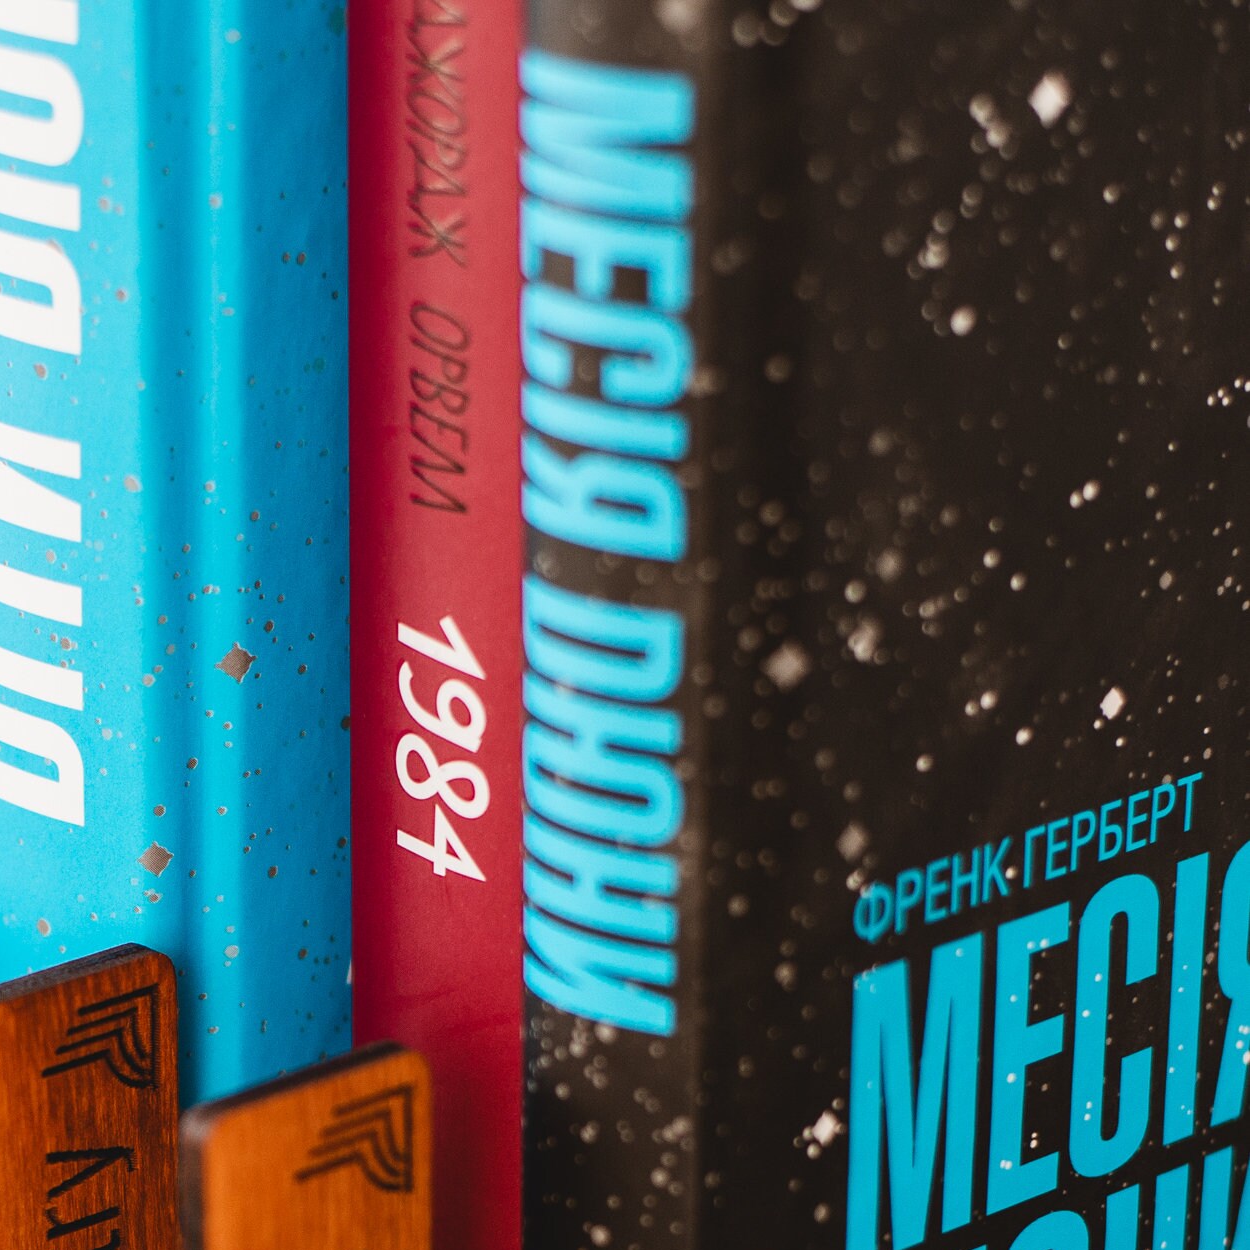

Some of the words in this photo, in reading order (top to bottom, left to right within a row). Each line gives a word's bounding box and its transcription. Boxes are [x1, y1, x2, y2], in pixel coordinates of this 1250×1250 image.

[518, 48, 695, 562] МЕСІЯ
[395, 614, 491, 883] 1984
[852, 837, 1014, 944] ФРЕНК
[1022, 771, 1205, 890] ГЕРБЕРТ
